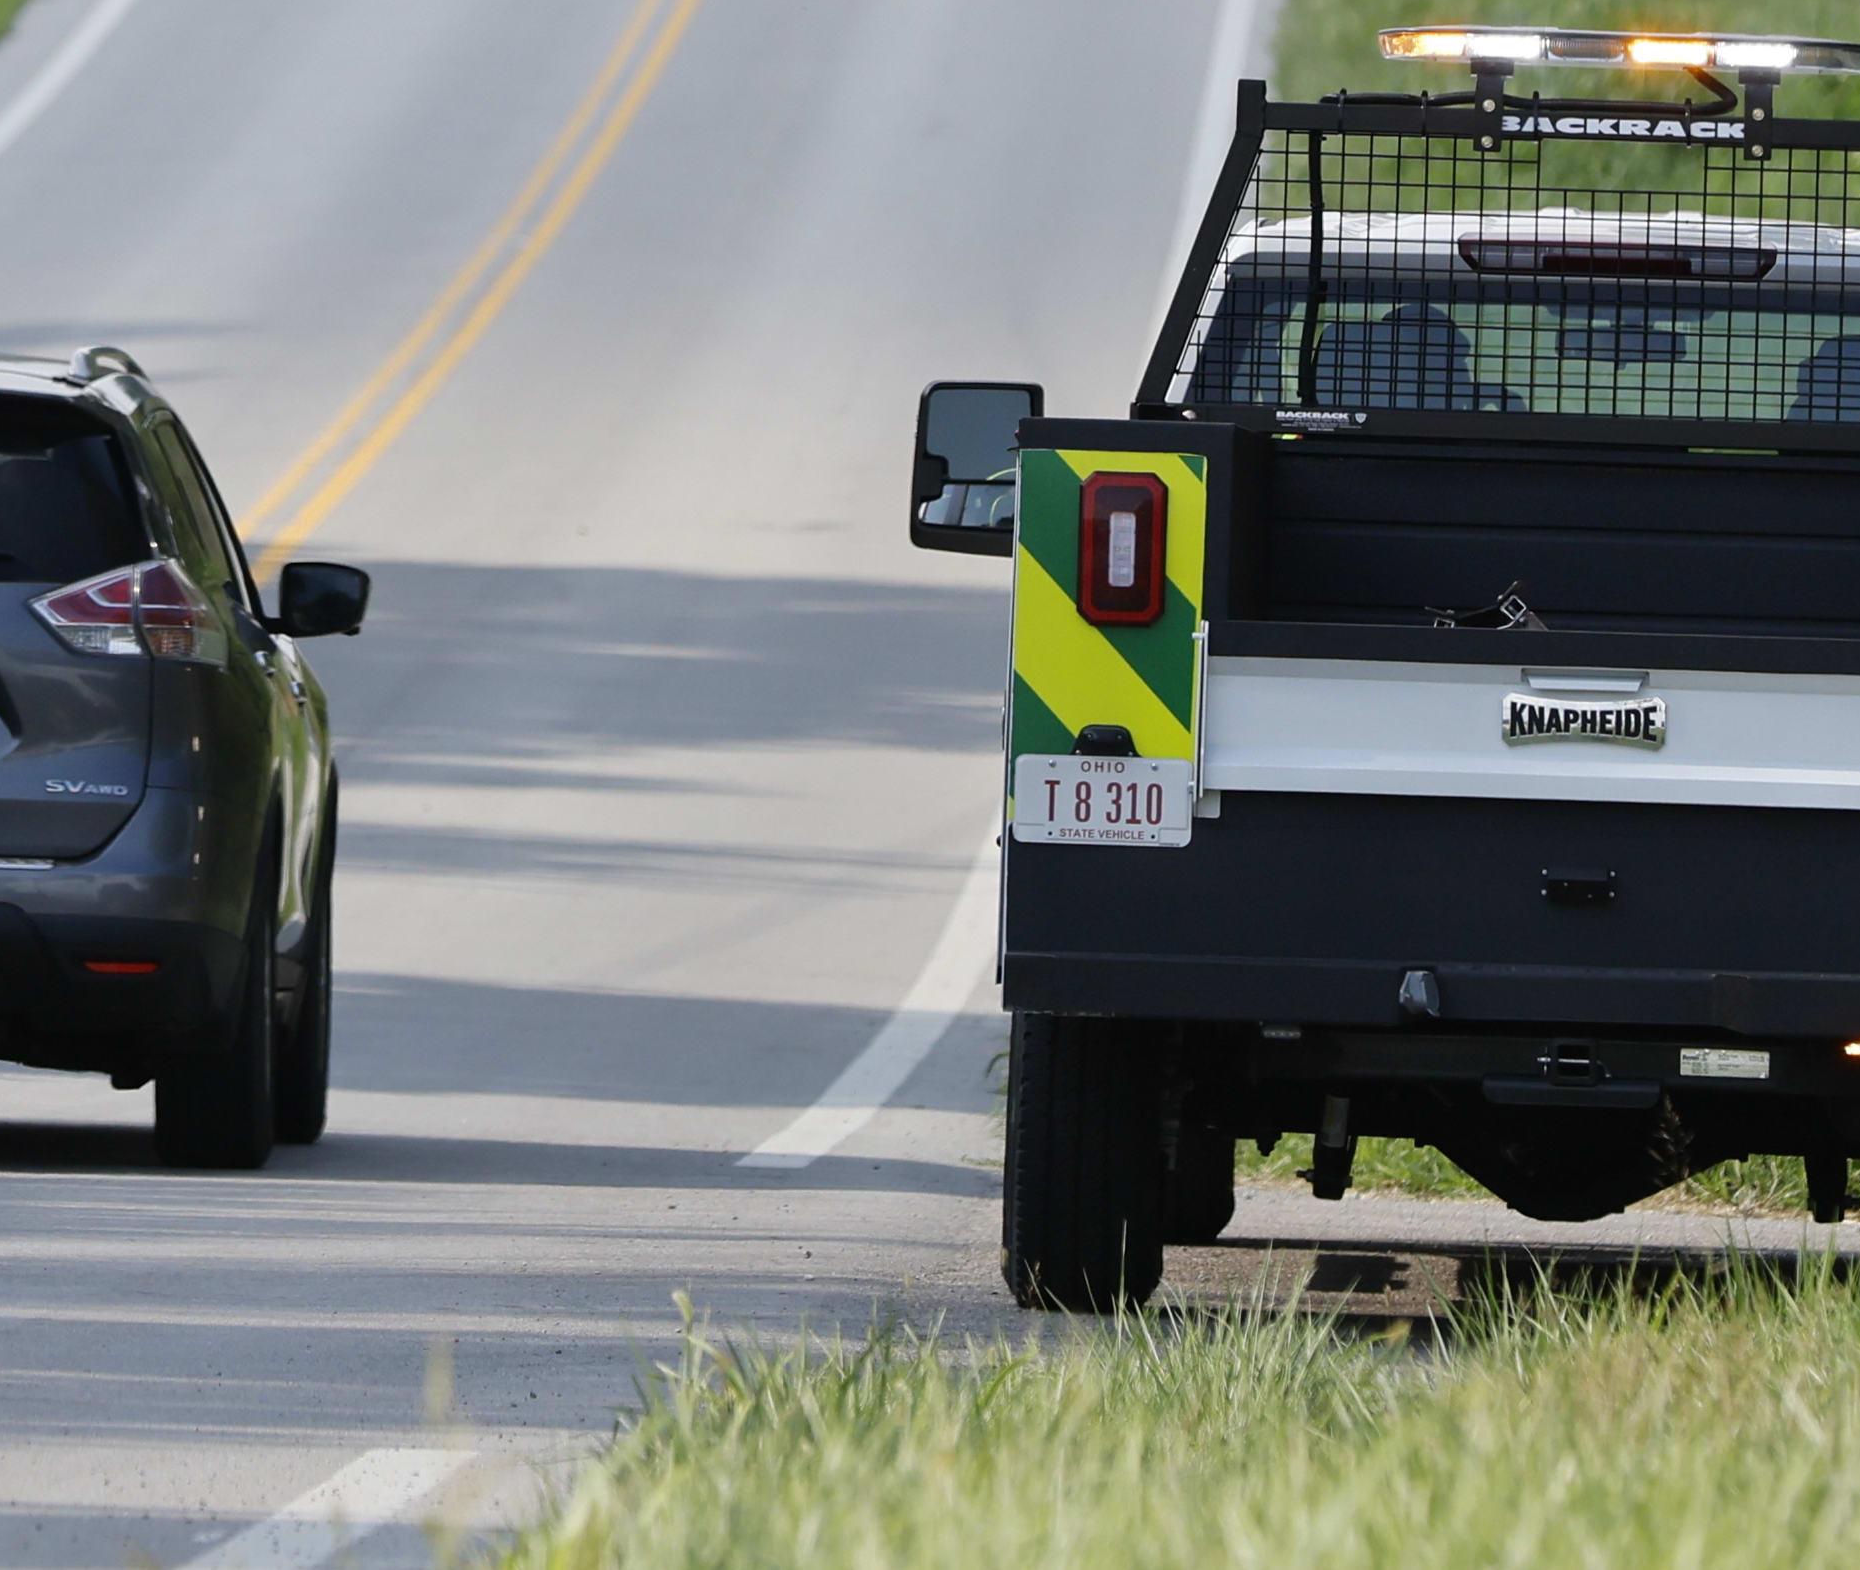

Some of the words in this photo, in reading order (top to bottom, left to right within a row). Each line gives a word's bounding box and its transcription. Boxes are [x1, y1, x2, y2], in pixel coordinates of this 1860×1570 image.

[1509, 700, 1658, 743] KNAPHEIDE
[1080, 760, 1126, 774] OHIO
[1044, 779, 1061, 823] T
[1074, 780, 1092, 823] 8
[1105, 781, 1164, 826] 310
[1058, 828, 1095, 839] STATE
[1098, 830, 1146, 841] VEHICLE
